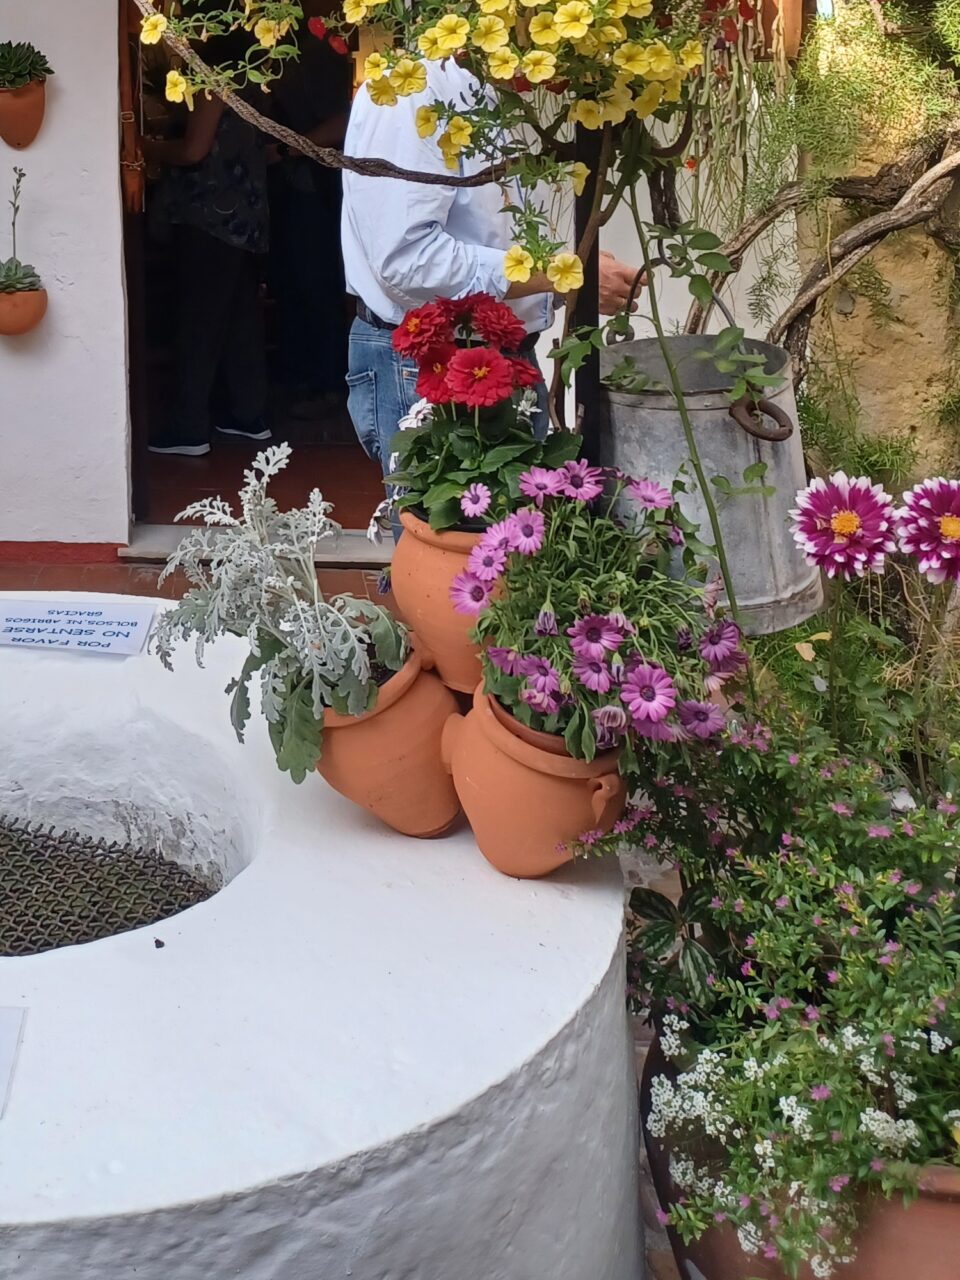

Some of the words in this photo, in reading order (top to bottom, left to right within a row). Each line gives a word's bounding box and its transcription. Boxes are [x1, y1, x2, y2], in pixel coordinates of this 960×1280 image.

[47, 609, 103, 617] GRACIAS
[1, 626, 96, 636] SENTARSE
[102, 630, 131, 638] NO
[11, 637, 70, 646] FAVOR
[77, 640, 112, 648] POR
